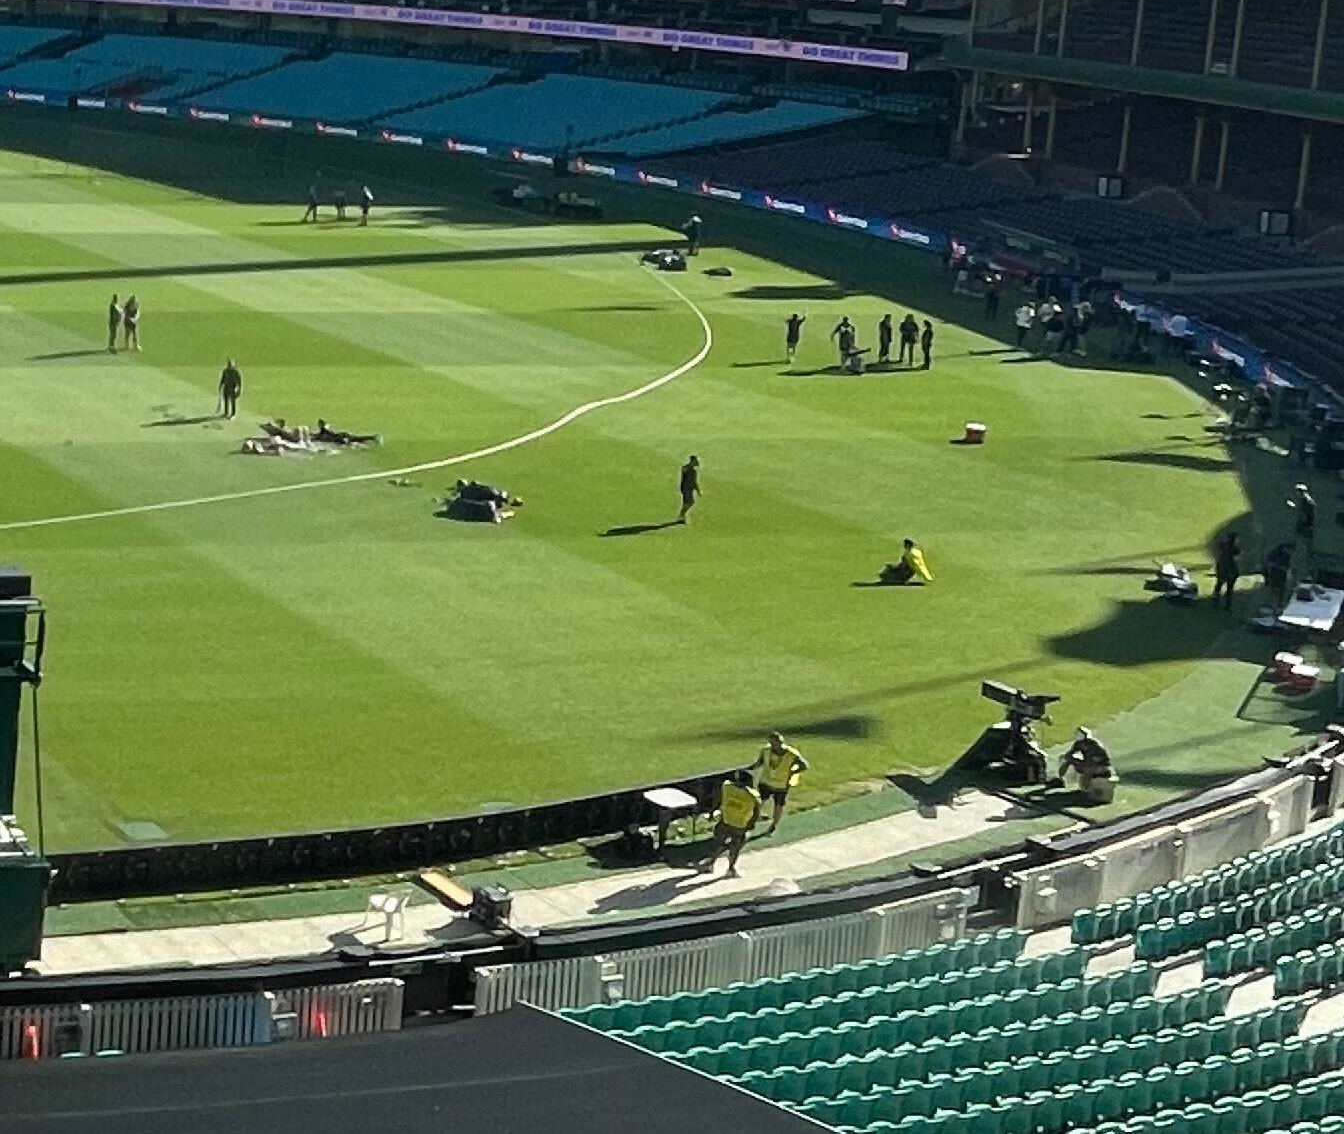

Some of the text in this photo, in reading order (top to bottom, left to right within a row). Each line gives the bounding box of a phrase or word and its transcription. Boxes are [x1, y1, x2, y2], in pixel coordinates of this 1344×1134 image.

[681, 33, 712, 47] GREAT
[803, 45, 898, 67] DO GREAT THINGS
